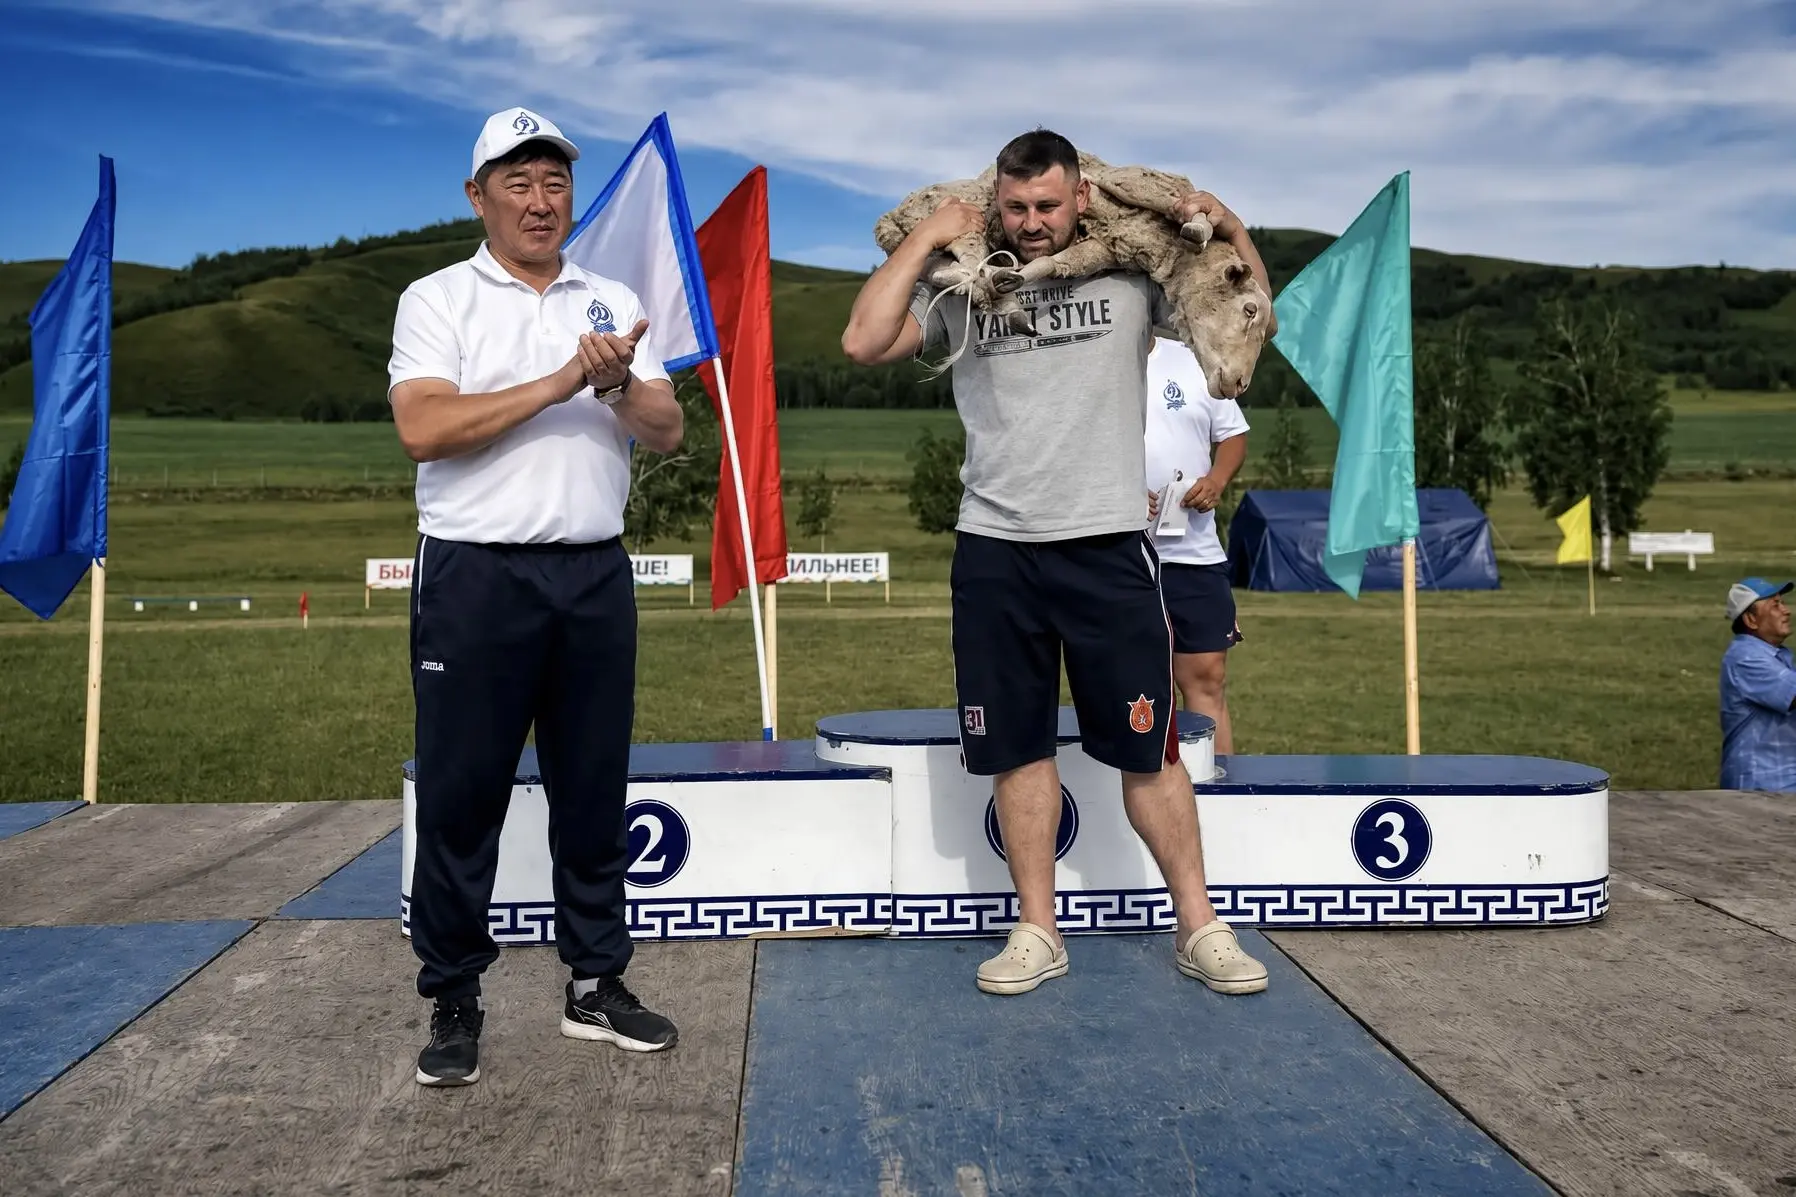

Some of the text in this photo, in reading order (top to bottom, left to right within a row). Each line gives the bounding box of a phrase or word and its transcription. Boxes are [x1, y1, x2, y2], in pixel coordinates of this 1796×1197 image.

[975, 299, 1112, 340] YAT STYLE
[380, 564, 411, 580] БЫ
[788, 558, 881, 574] ИЛЬНЕЕ!
[627, 813, 667, 873] 2
[1375, 811, 1410, 869] 3
